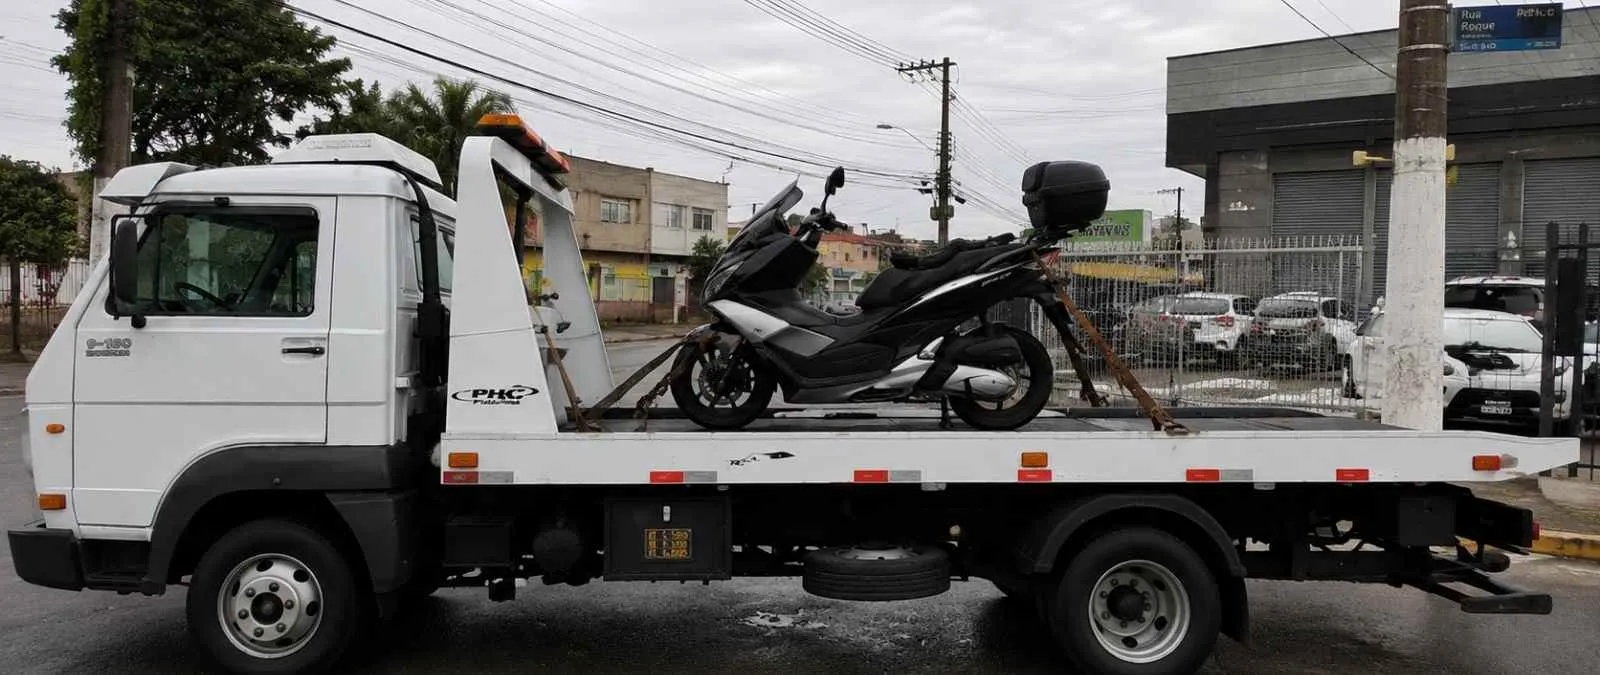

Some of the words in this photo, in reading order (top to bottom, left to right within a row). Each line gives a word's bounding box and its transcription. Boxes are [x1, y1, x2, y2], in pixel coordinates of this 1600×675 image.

[1461, 10, 1482, 19] Rua
[1461, 22, 1496, 32] Roque
[471, 389, 526, 400] PHC
